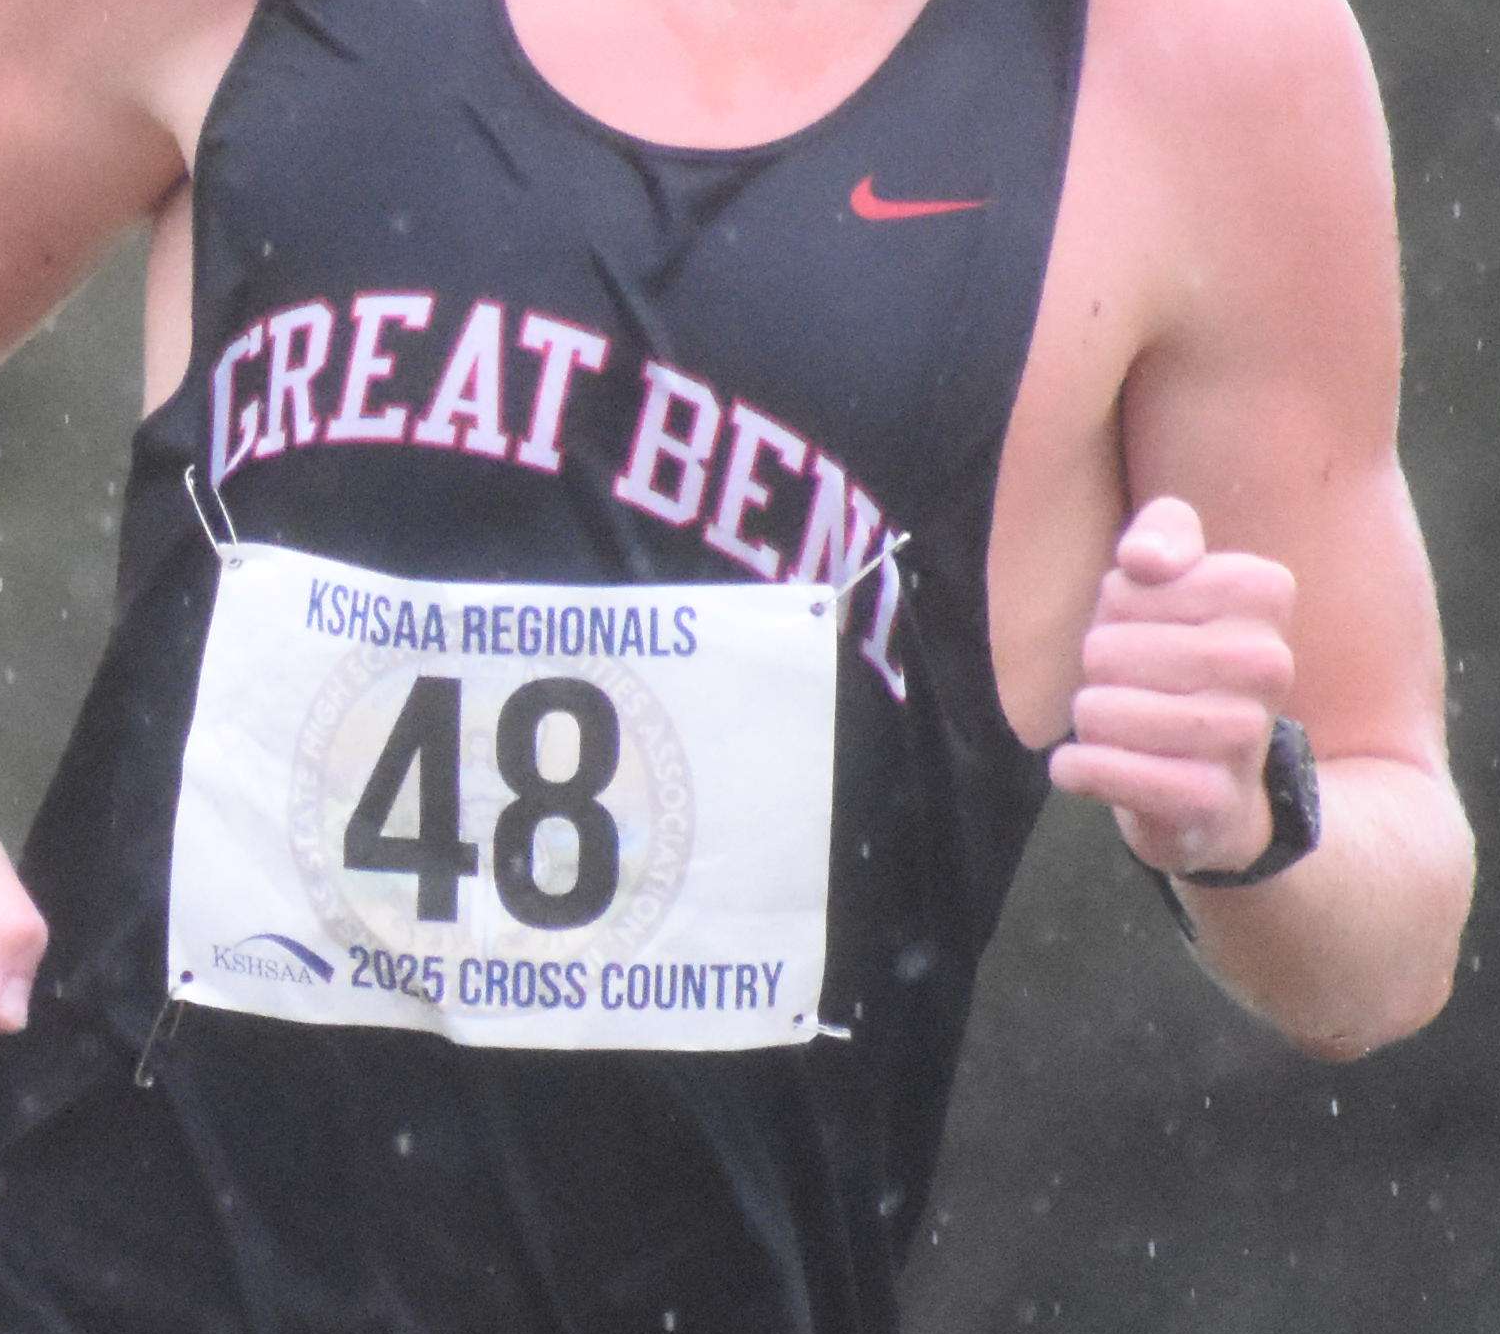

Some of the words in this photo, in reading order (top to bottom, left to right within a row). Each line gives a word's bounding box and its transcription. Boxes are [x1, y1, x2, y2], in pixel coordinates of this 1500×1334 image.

[211, 290, 608, 489] GREAT
[307, 577, 446, 653] KSHSAA
[461, 604, 698, 657] REGIONALS
[342, 675, 620, 931] 48
[212, 945, 313, 984] KSHSAA
[350, 945, 445, 1005] 2025
[459, 958, 588, 1010] CROSS
[600, 960, 784, 1011] COUNTRY
